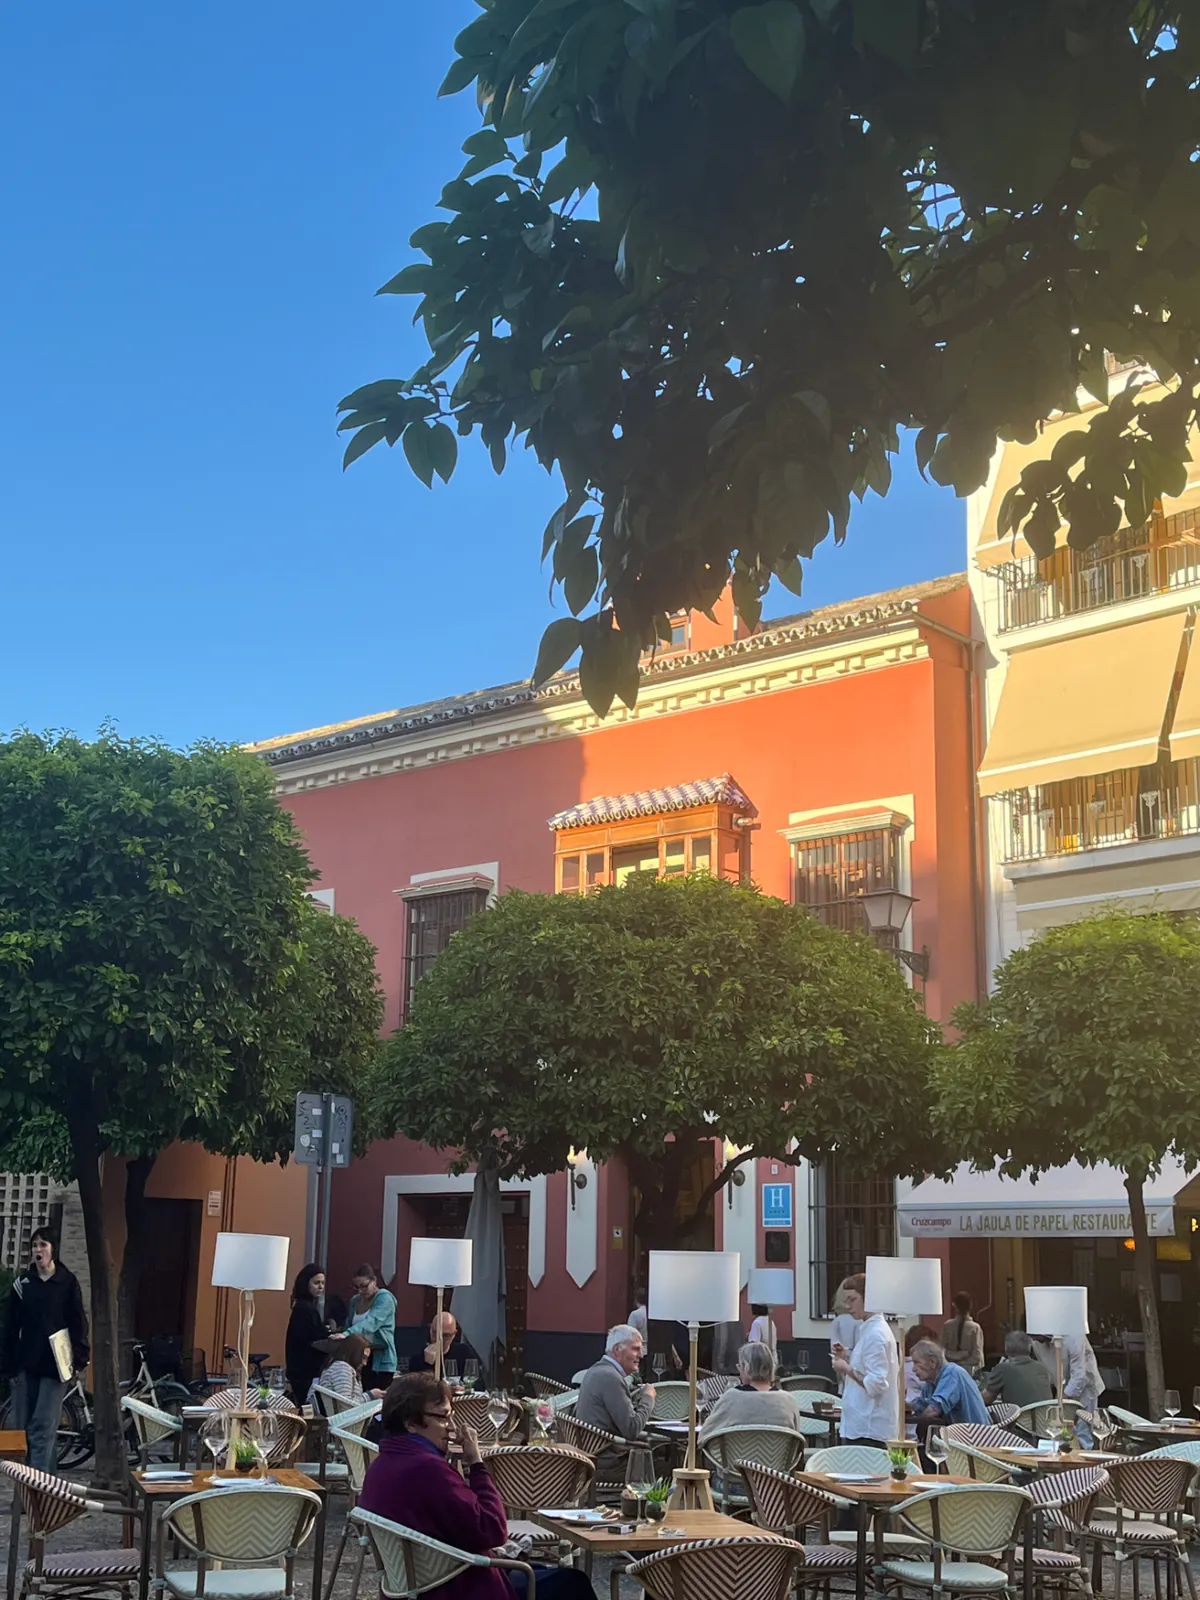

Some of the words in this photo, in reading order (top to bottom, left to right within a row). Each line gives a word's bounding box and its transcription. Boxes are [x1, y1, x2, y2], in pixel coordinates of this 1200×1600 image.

[770, 1188, 784, 1207] H
[911, 1217, 952, 1227] Cruzcampo
[960, 1215, 973, 1231] LA
[976, 1214, 1011, 1231] JAULA
[1015, 1214, 1029, 1231] DE
[1033, 1214, 1069, 1231] PAPEL
[1073, 1213, 1157, 1230] RESTAURATE
